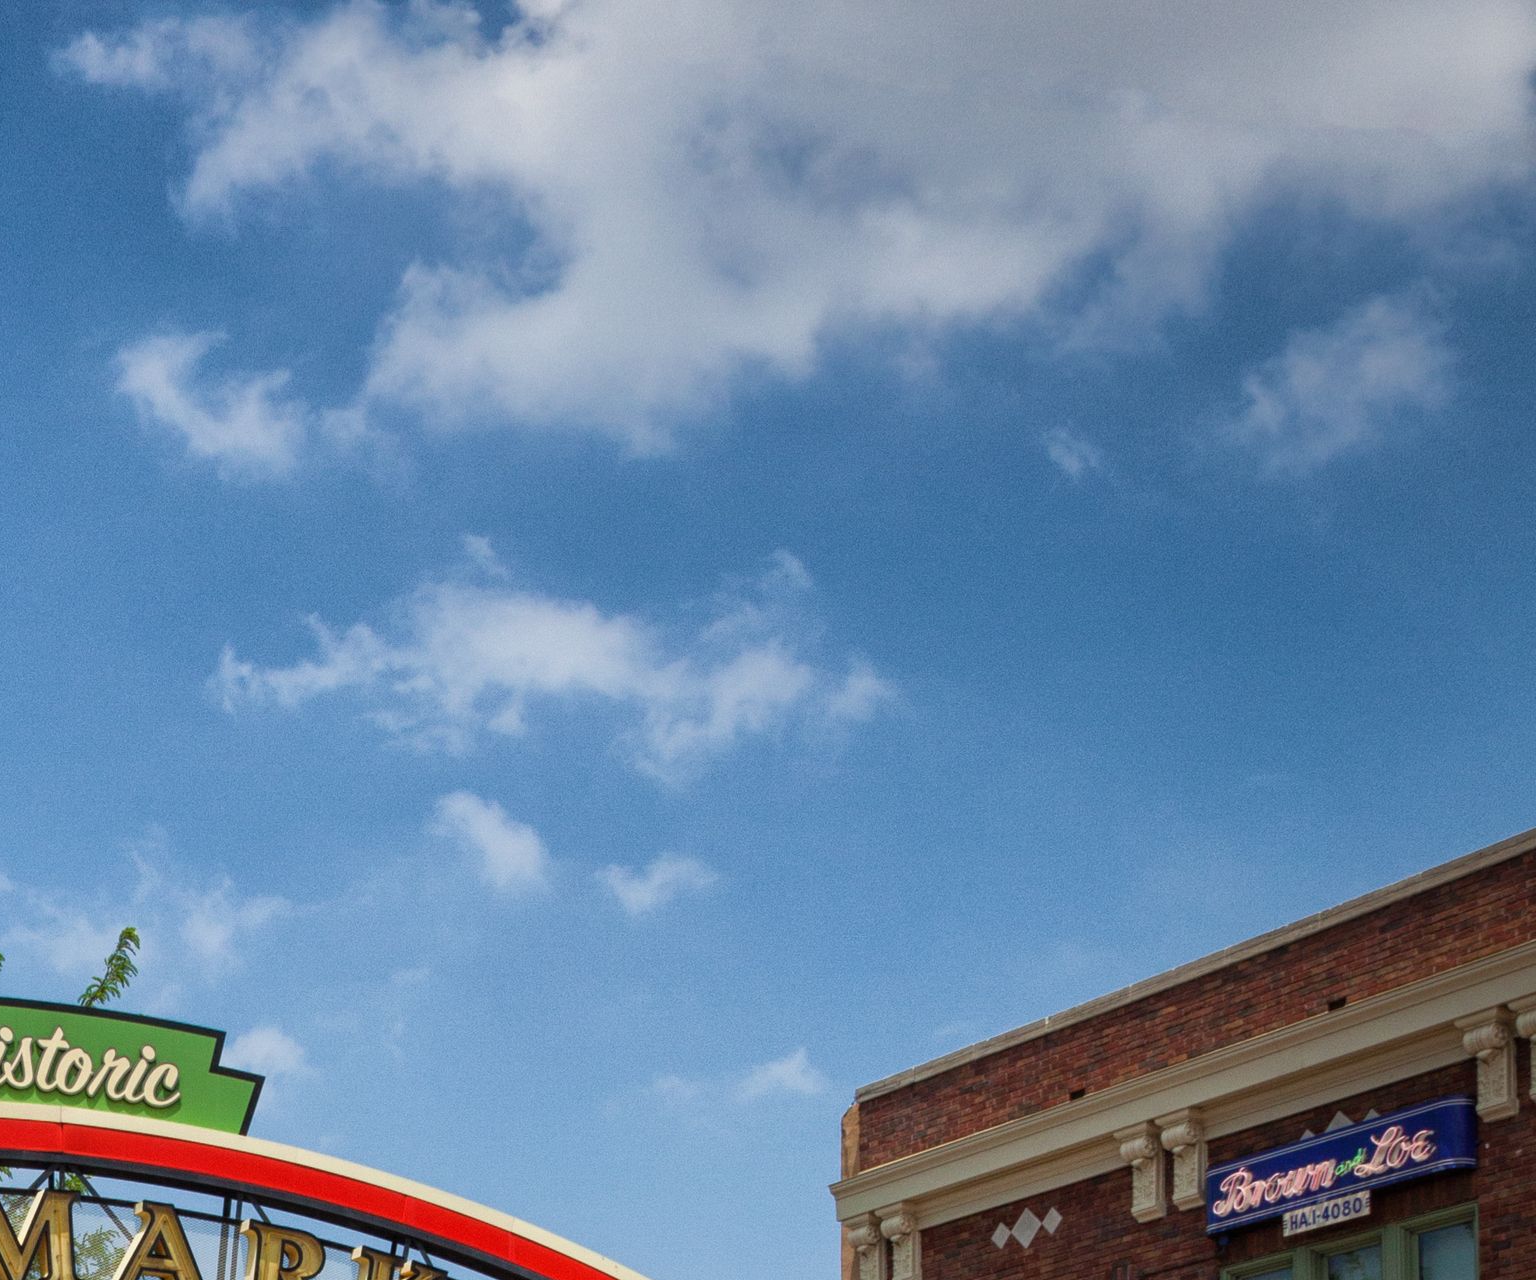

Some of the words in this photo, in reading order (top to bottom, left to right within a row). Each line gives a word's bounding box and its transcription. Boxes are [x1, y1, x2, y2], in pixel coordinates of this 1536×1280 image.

[1212, 1157, 1338, 1218] Brown
[1335, 1147, 1367, 1177] and
[1353, 1125, 1437, 1178] Loe
